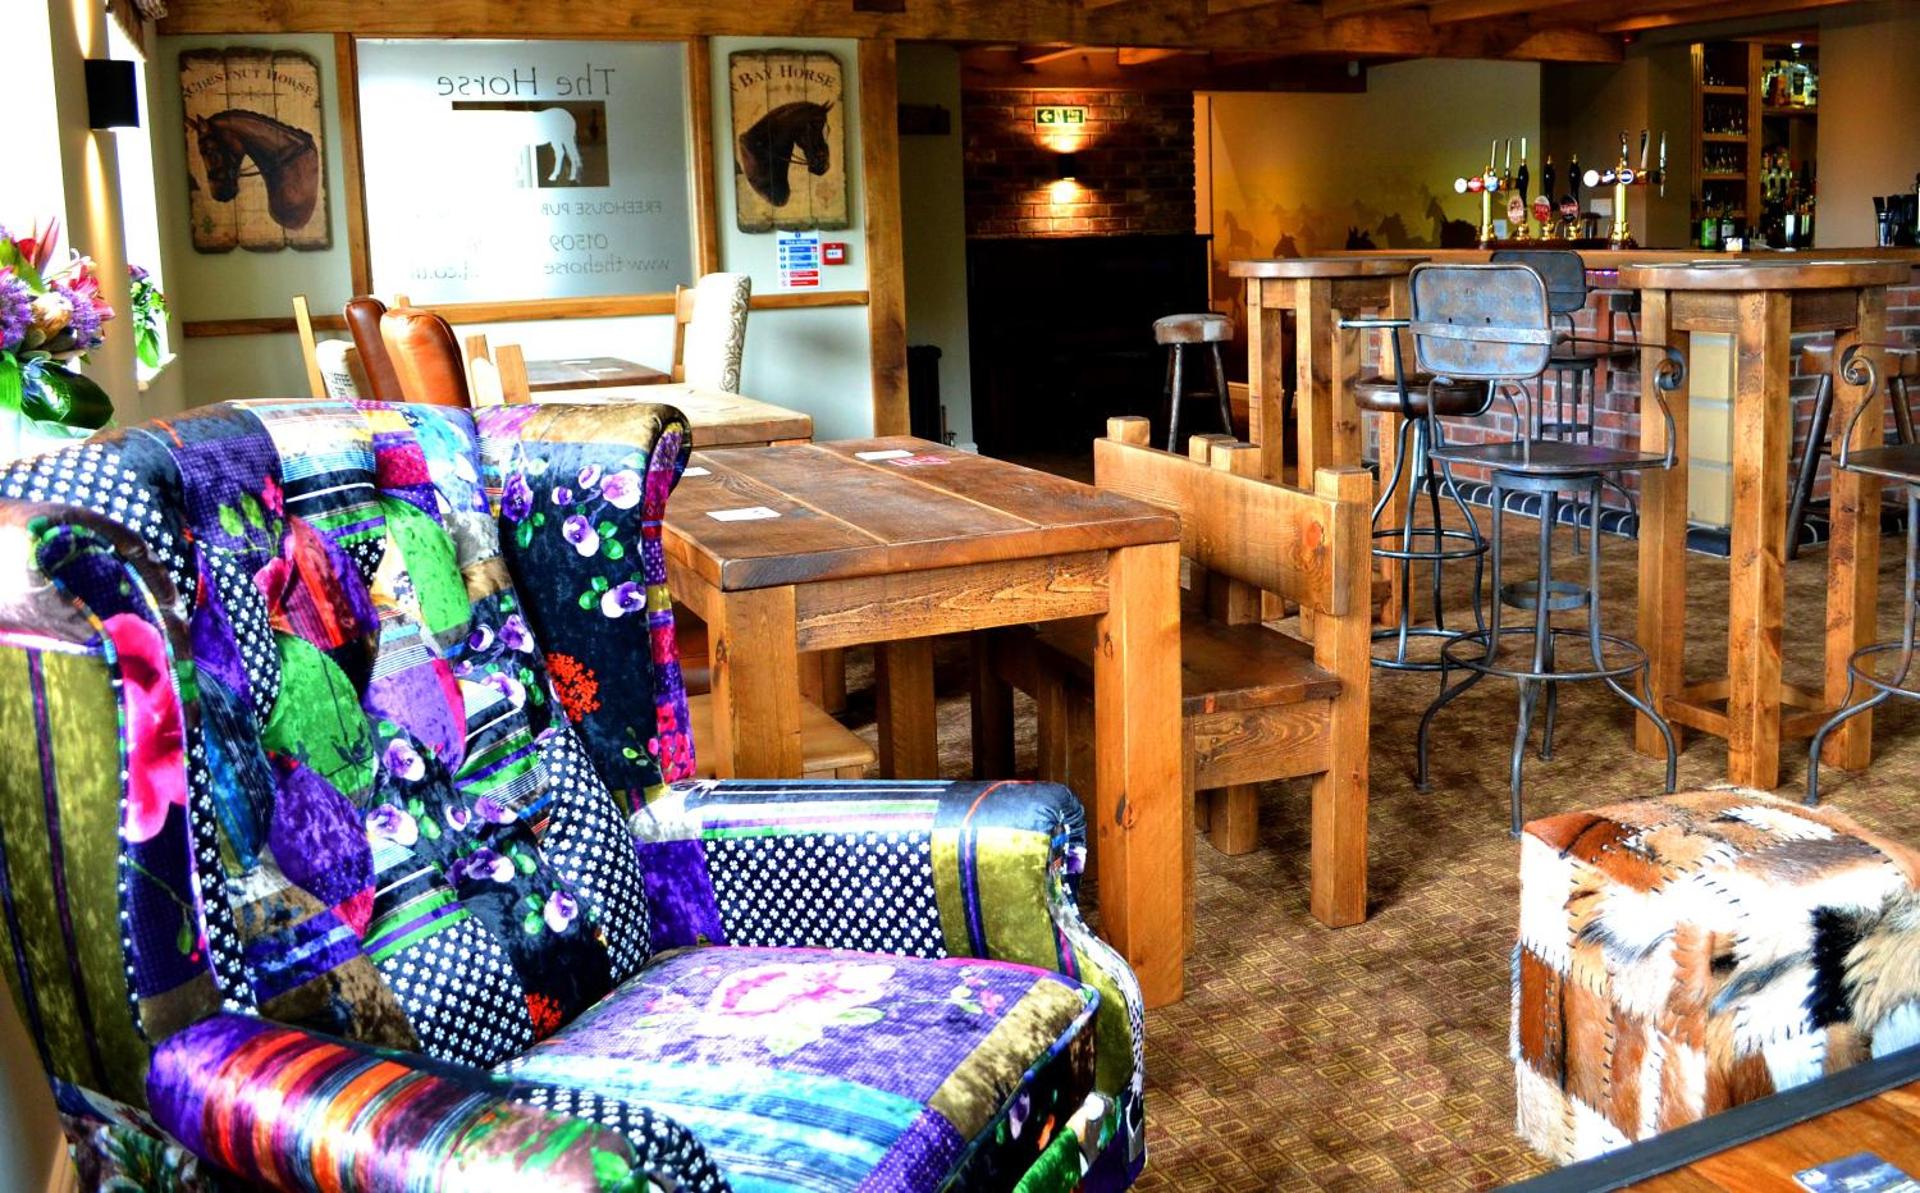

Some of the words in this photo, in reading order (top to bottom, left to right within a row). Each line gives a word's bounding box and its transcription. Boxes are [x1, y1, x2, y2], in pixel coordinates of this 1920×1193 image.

[266, 68, 315, 97] HORSE
[739, 66, 773, 88] BAY
[780, 64, 835, 88] HORSE
